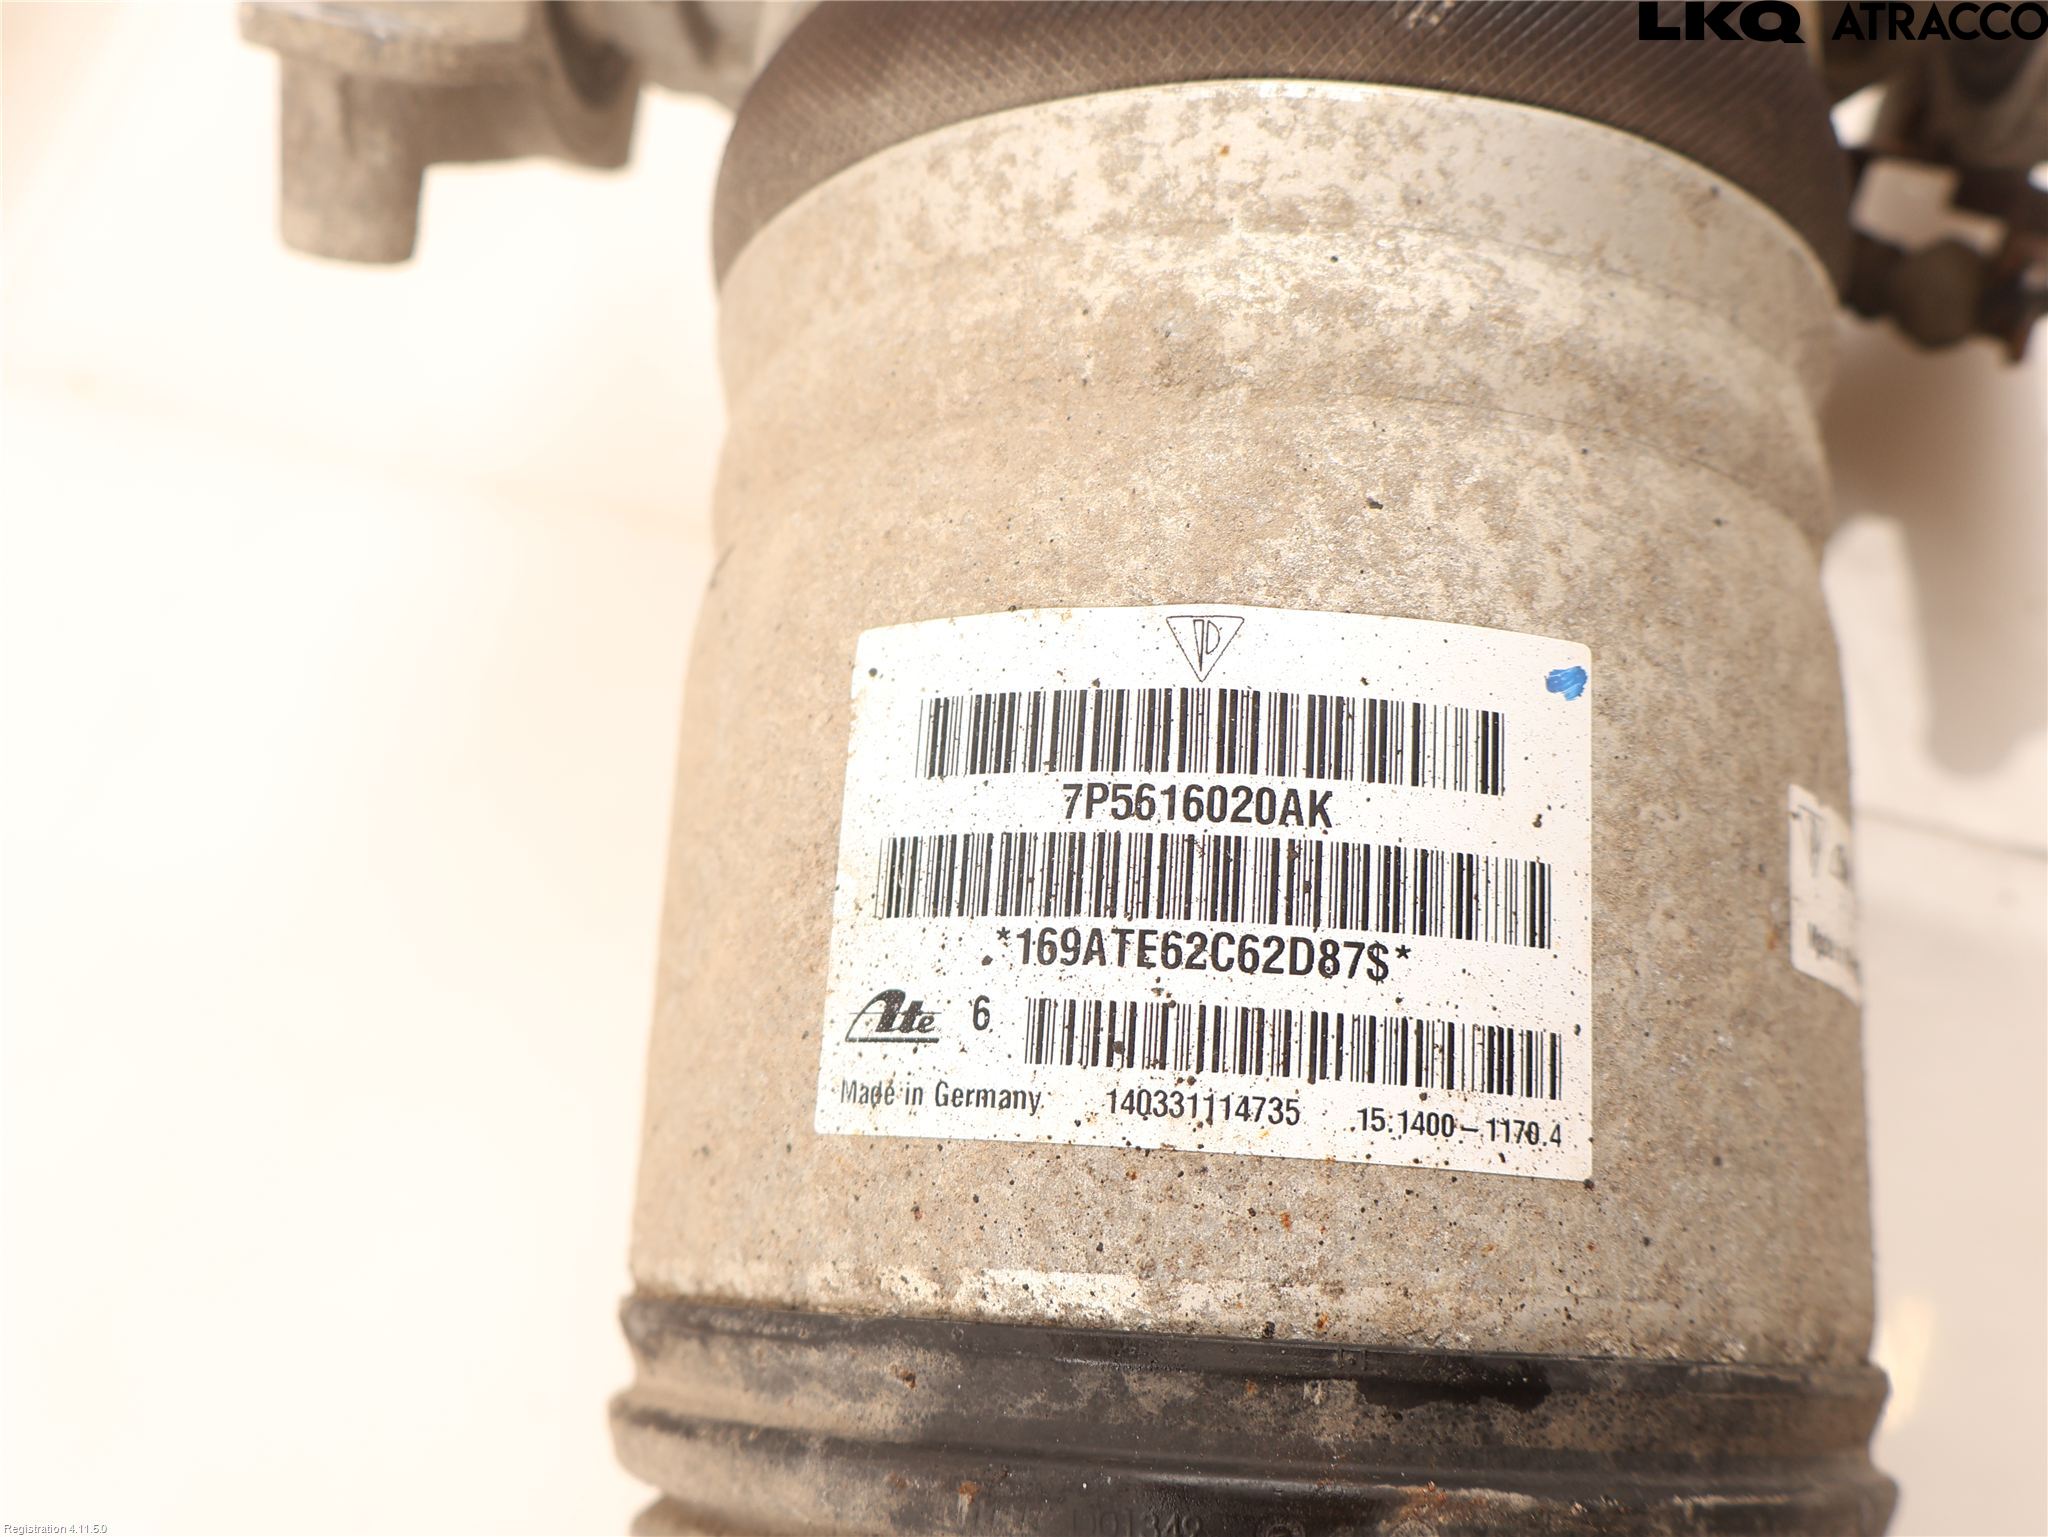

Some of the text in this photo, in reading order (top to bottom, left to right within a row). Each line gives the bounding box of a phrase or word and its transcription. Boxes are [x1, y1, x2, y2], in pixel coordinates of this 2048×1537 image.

[1062, 782, 1333, 828] 7P5616020AK
[972, 994, 991, 1031] 6
[840, 1079, 1042, 1117] Made in Germany
[1105, 1088, 1300, 1126] 140331114735
